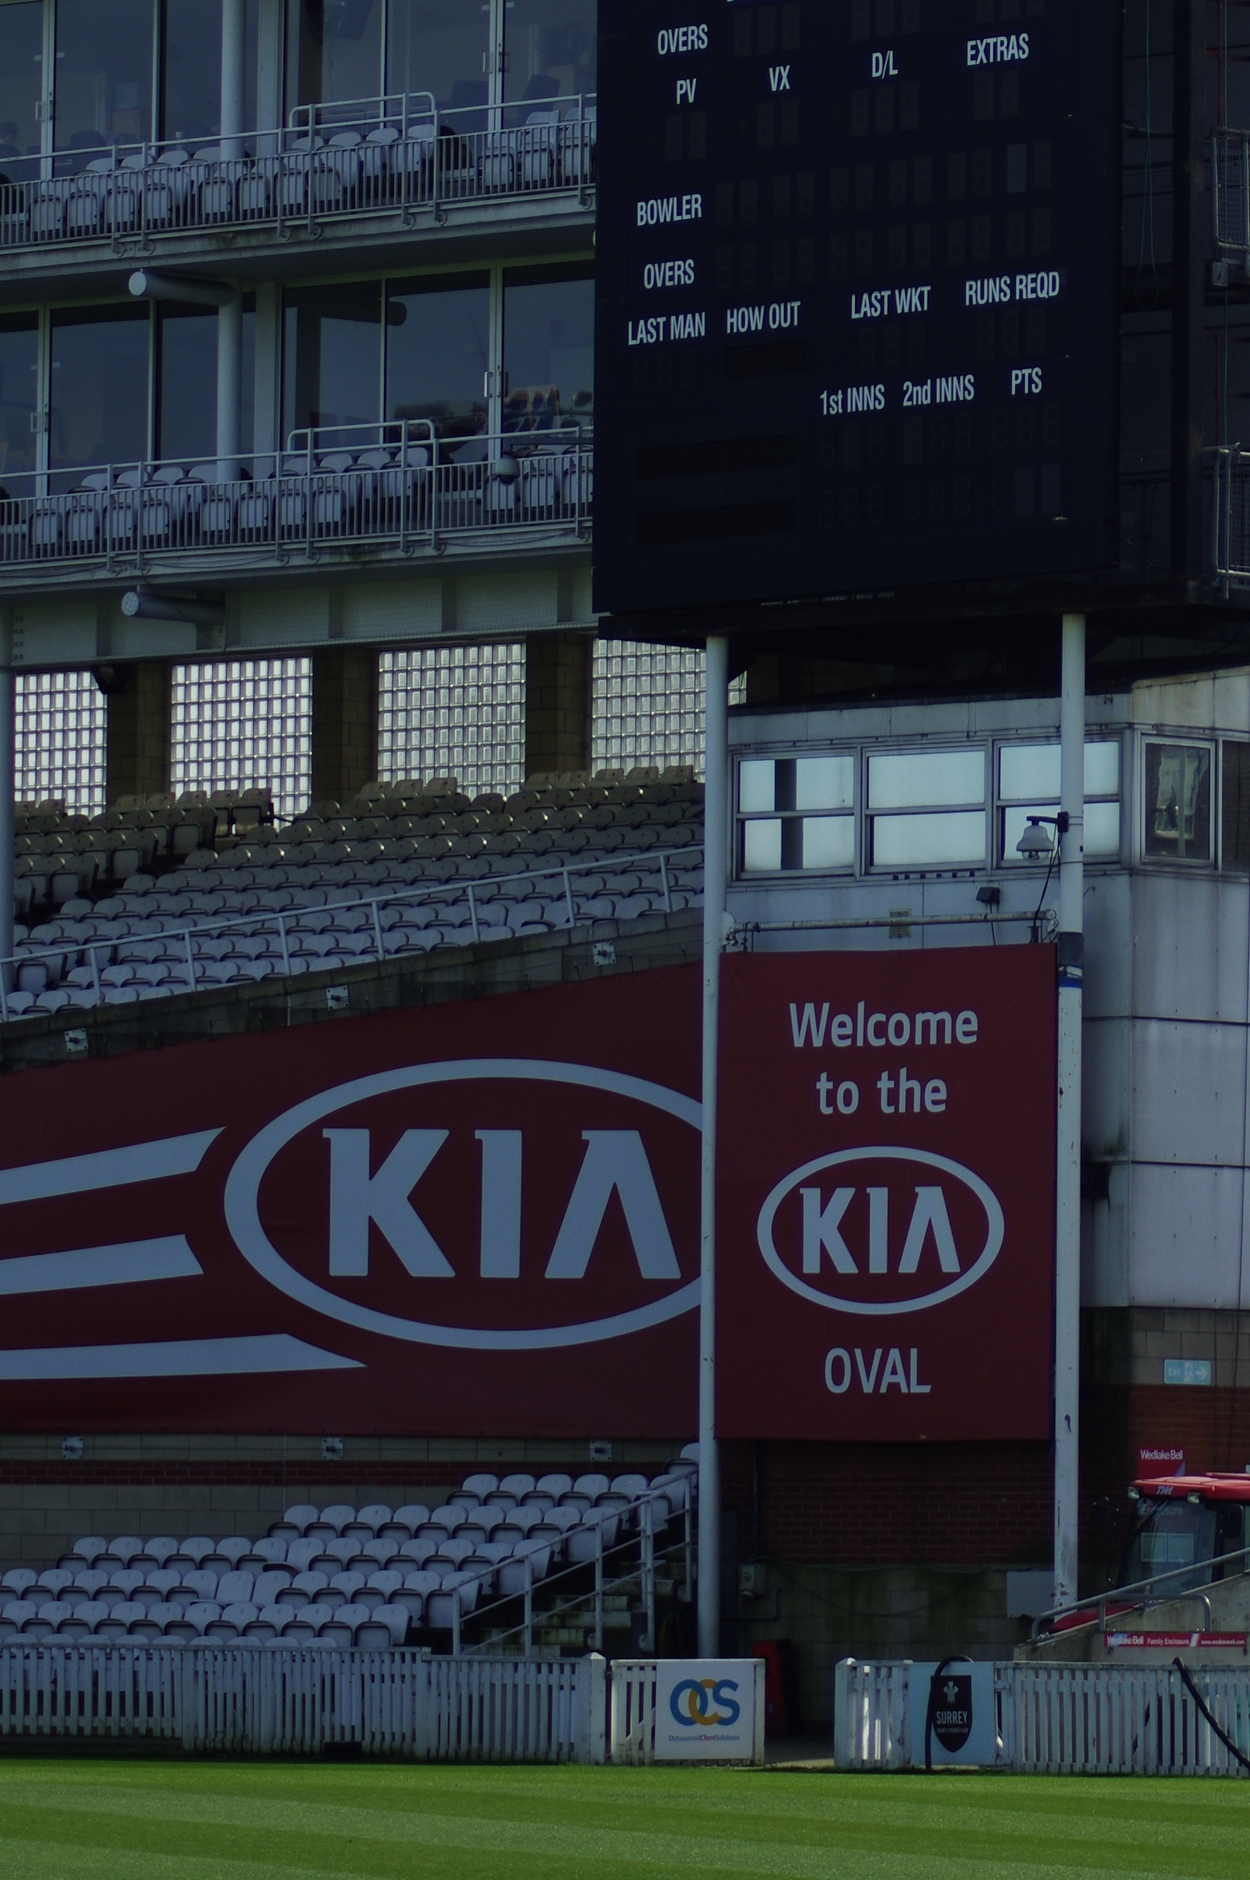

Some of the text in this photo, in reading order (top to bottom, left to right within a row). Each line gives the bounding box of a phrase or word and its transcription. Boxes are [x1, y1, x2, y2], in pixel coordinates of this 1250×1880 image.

[658, 24, 707, 54] OVERS
[967, 33, 1029, 65] EXTRAS
[769, 65, 790, 91] VX
[872, 51, 898, 79] D/L
[677, 78, 696, 104] PV
[638, 194, 701, 226] BOWLER
[644, 259, 694, 289] OVERS
[966, 272, 1059, 305] RUNS REQD
[727, 301, 800, 333] HOW OUT
[852, 286, 931, 318] LAST WKT
[629, 312, 705, 345] LAST MAN
[903, 375, 974, 406] 2nd INNS
[1012, 367, 1042, 395] PTS
[820, 384, 884, 415] 1st INNS
[790, 1001, 978, 1047] Welcome
[816, 1067, 947, 1114] to the
[323, 1128, 681, 1279] KIA
[798, 1186, 960, 1275] KIA
[825, 1348, 931, 1393] OVAL
[1140, 1450, 1183, 1459] Wedlake Bell
[1107, 1635, 1132, 1645] Wedlake
[1133, 1636, 1144, 1644] Bell
[1147, 1638, 1163, 1646] Family
[670, 1679, 740, 1726] OCS
[936, 1710, 968, 1724] SURREY
